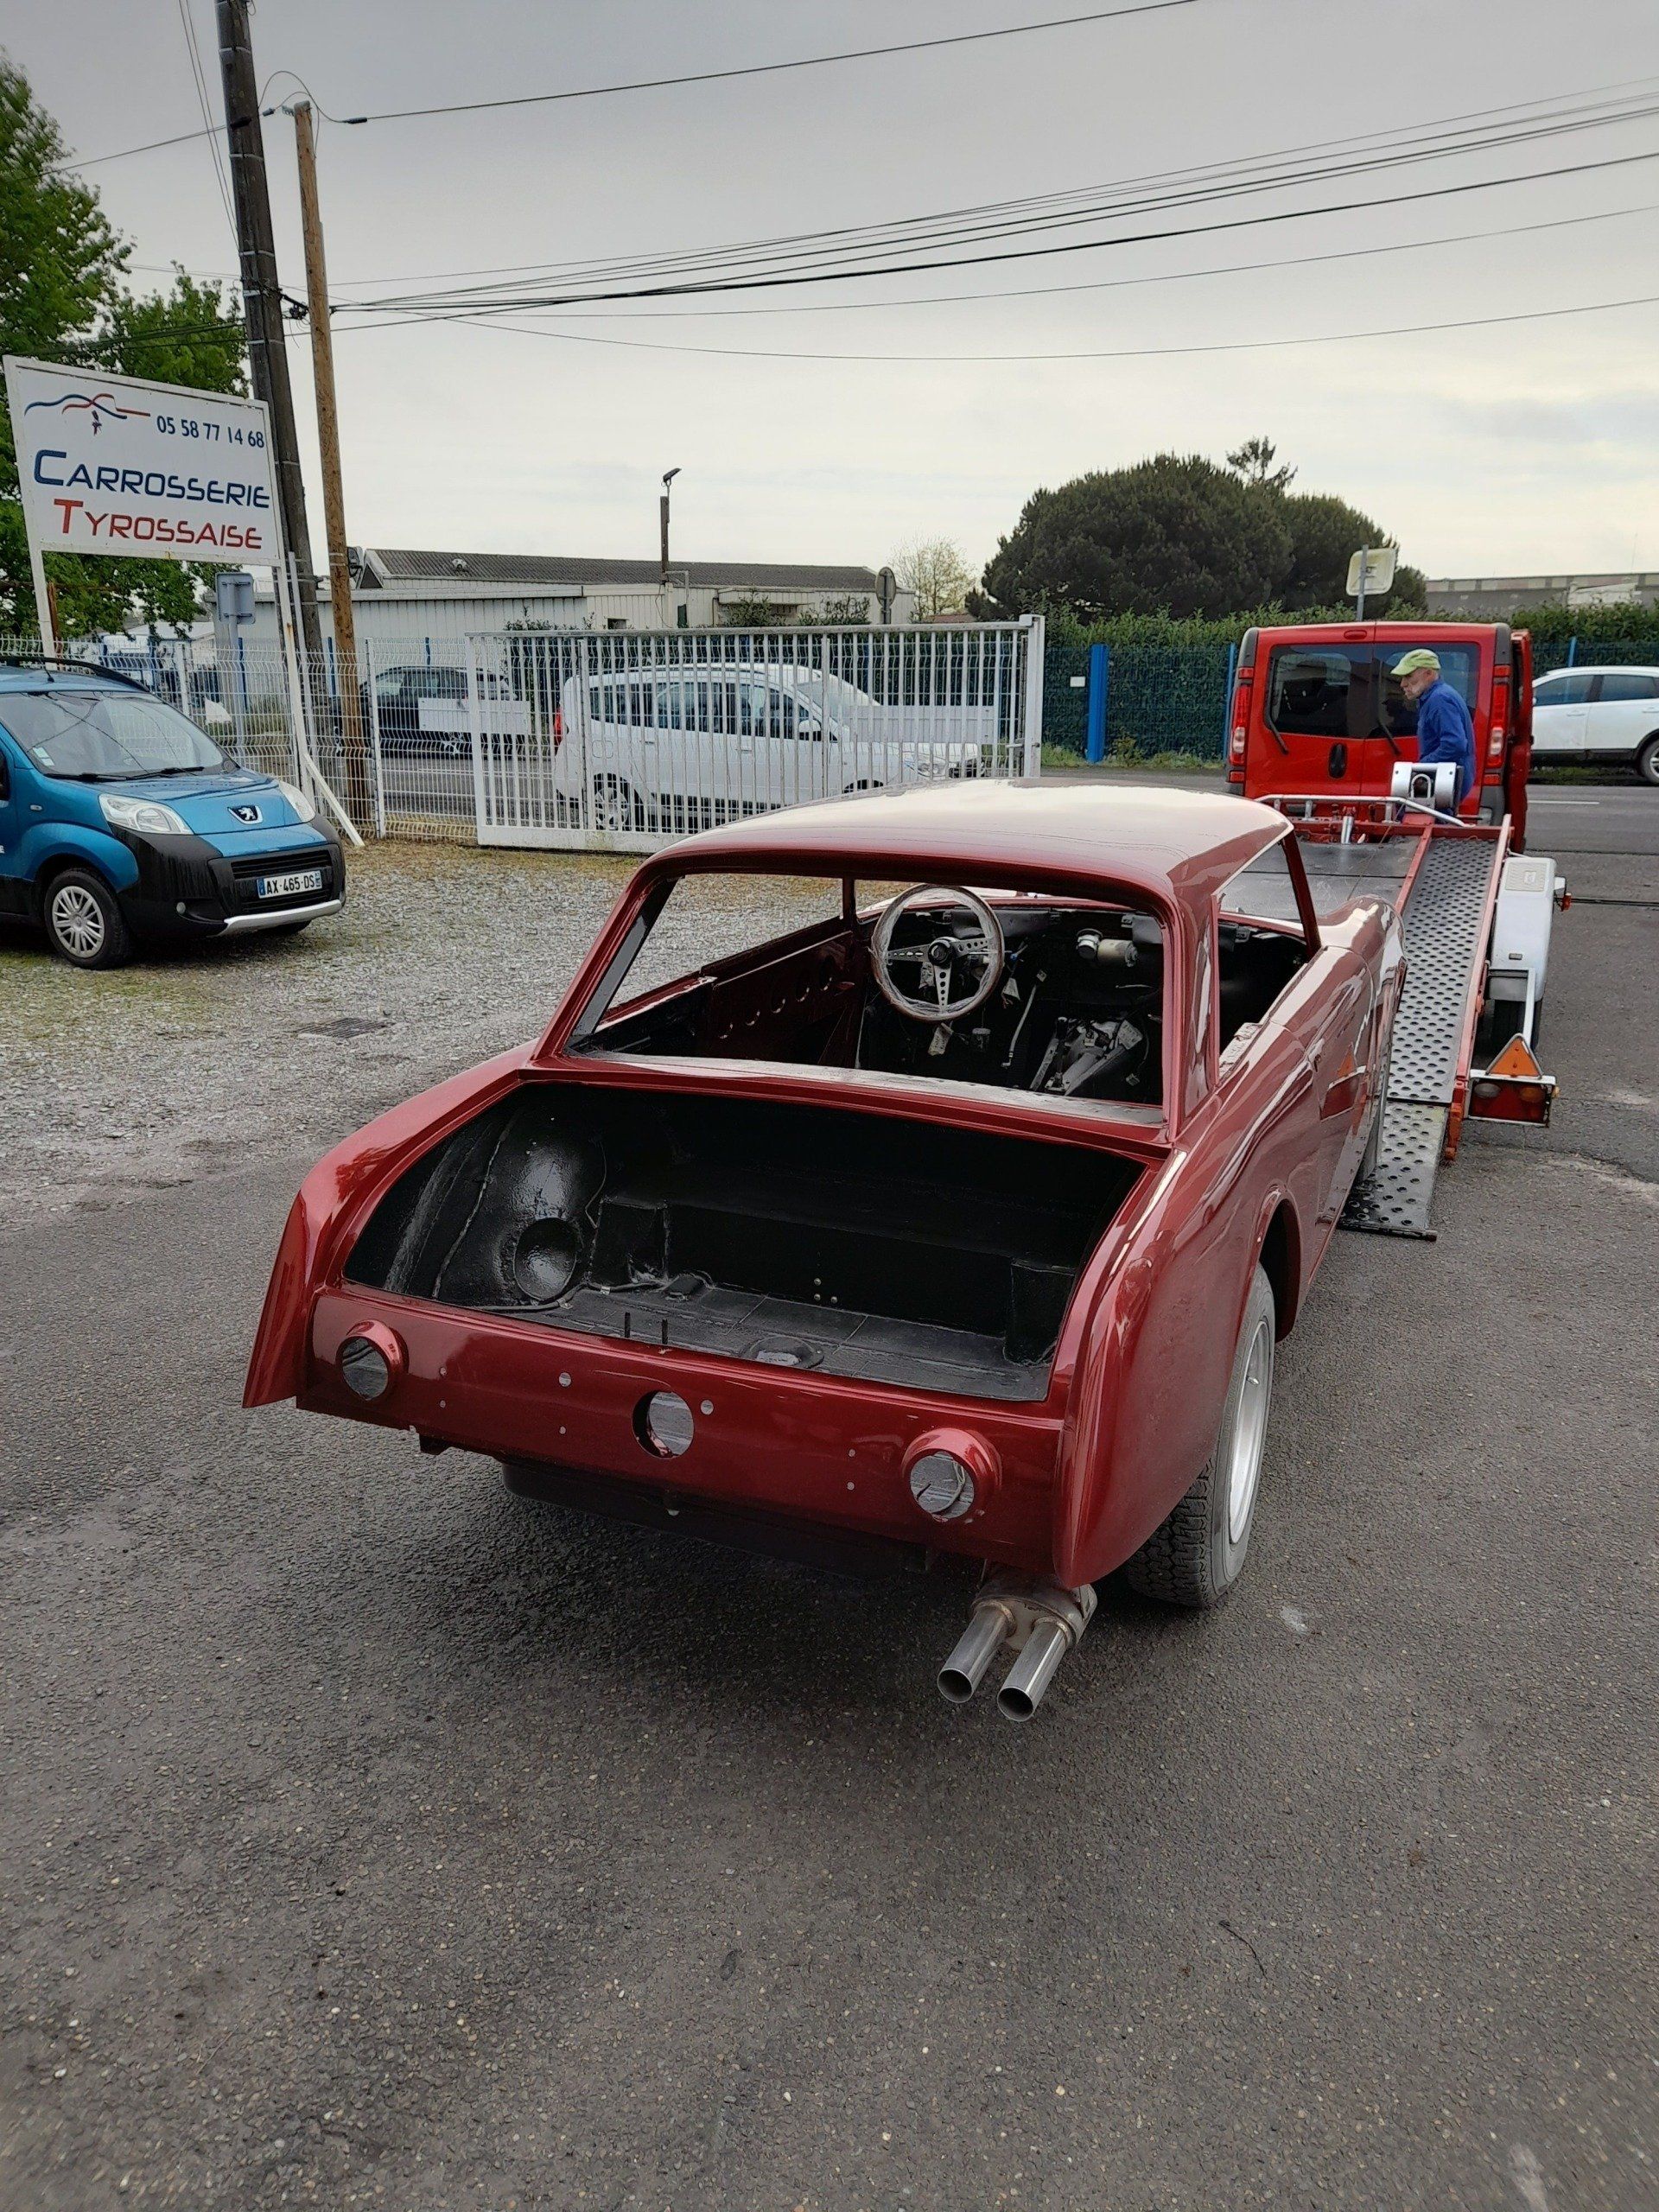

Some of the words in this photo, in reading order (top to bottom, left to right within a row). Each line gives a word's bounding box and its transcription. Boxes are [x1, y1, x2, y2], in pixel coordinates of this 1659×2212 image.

[156, 415, 175, 435] 05
[181, 418, 200, 438] 58
[202, 422, 220, 442] 77
[227, 426, 244, 446] 14
[247, 429, 264, 448] 68
[34, 448, 270, 509] CARROSSERIE
[54, 498, 263, 550] TYROSSAISE
